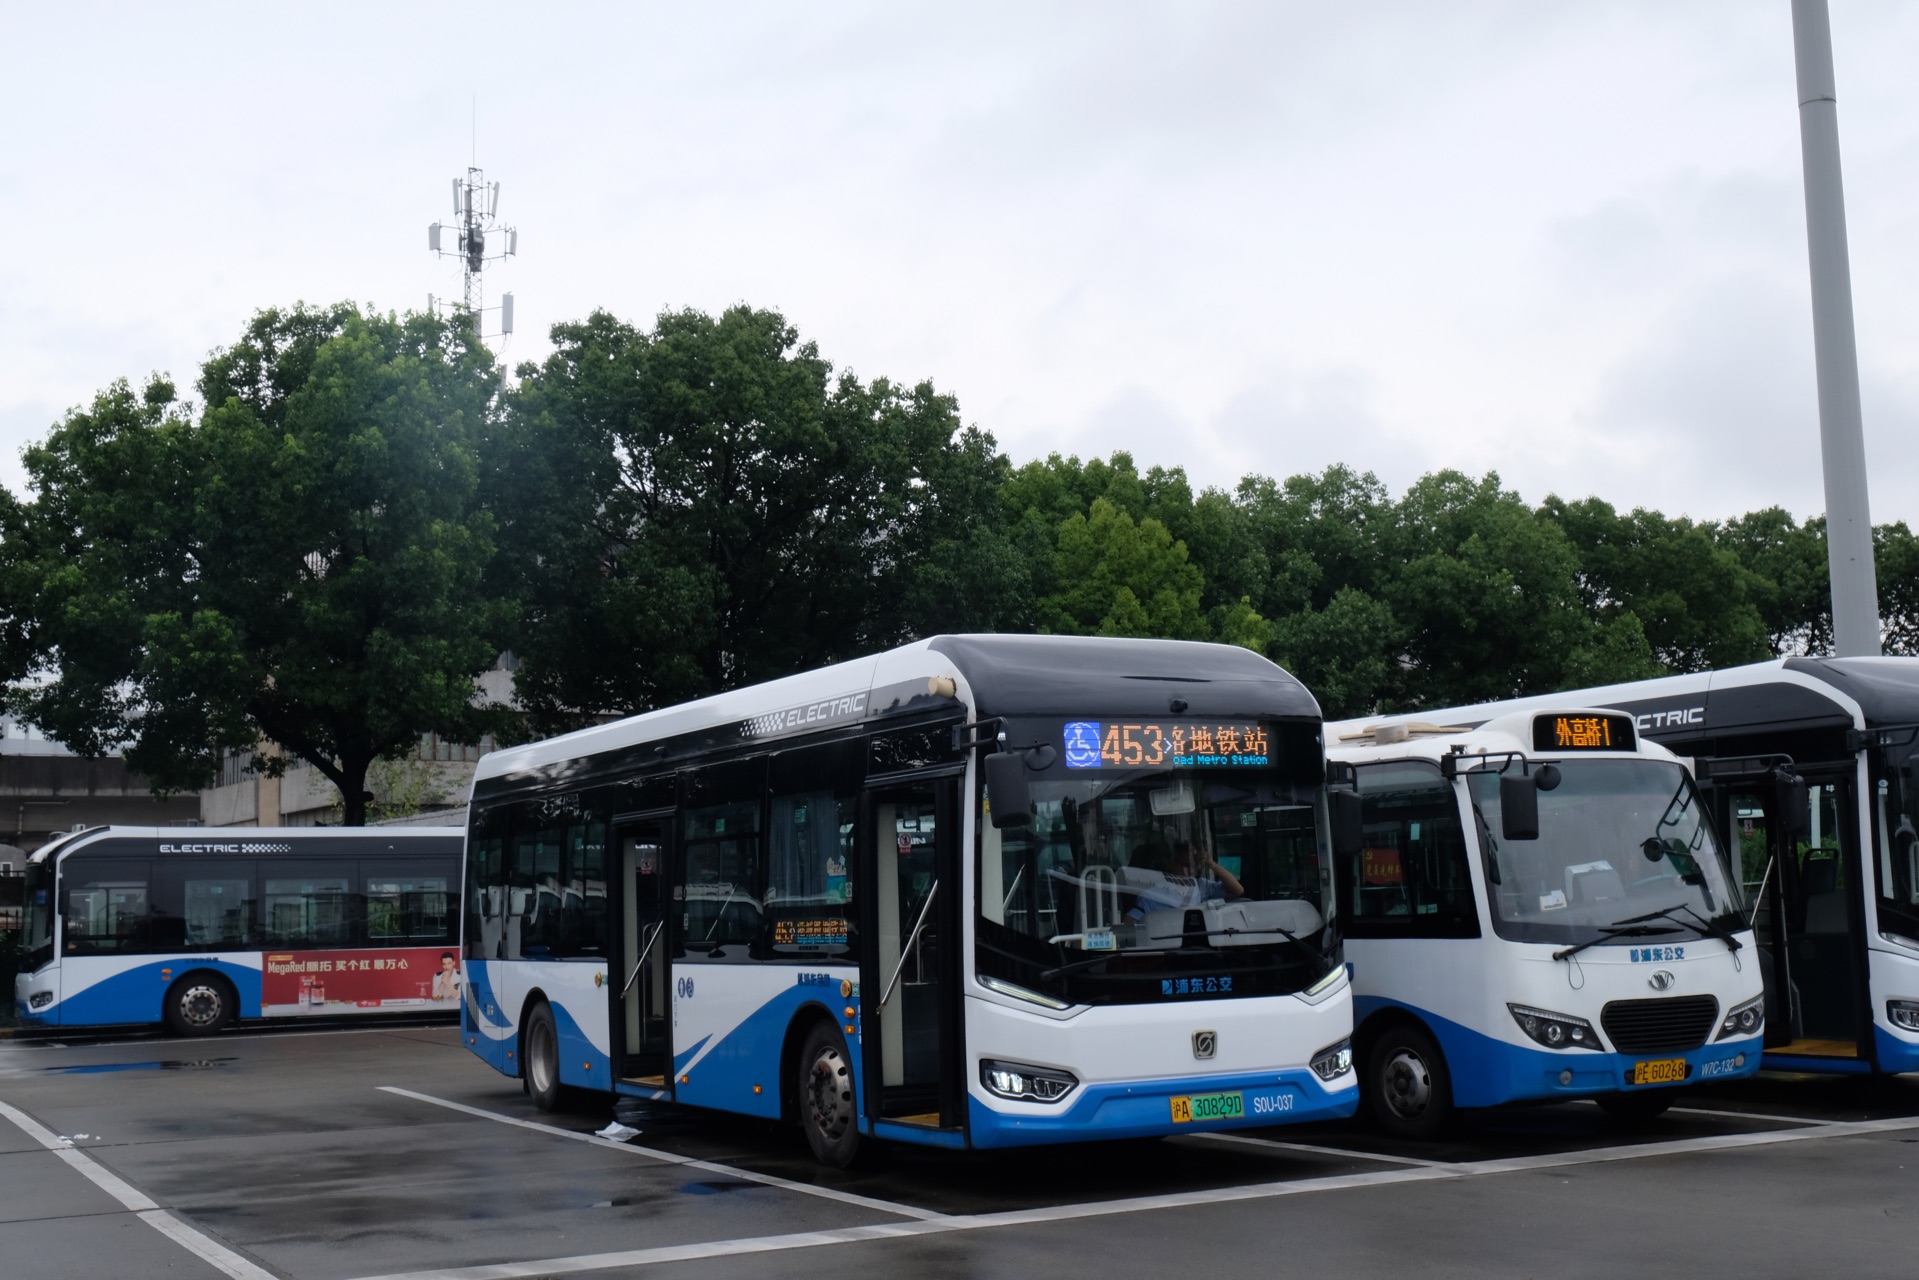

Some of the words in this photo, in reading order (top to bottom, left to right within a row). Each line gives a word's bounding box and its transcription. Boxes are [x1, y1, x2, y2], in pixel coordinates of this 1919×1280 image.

[786, 693, 866, 727] ELECTRIC
[1634, 707, 1704, 730] CTRIC
[1101, 725, 1163, 765] 453
[1197, 755, 1228, 765] Metro
[1232, 755, 1268, 765] Station
[159, 844, 239, 853] ELECTRIC
[1176, 977, 1233, 994] 浦东公交
